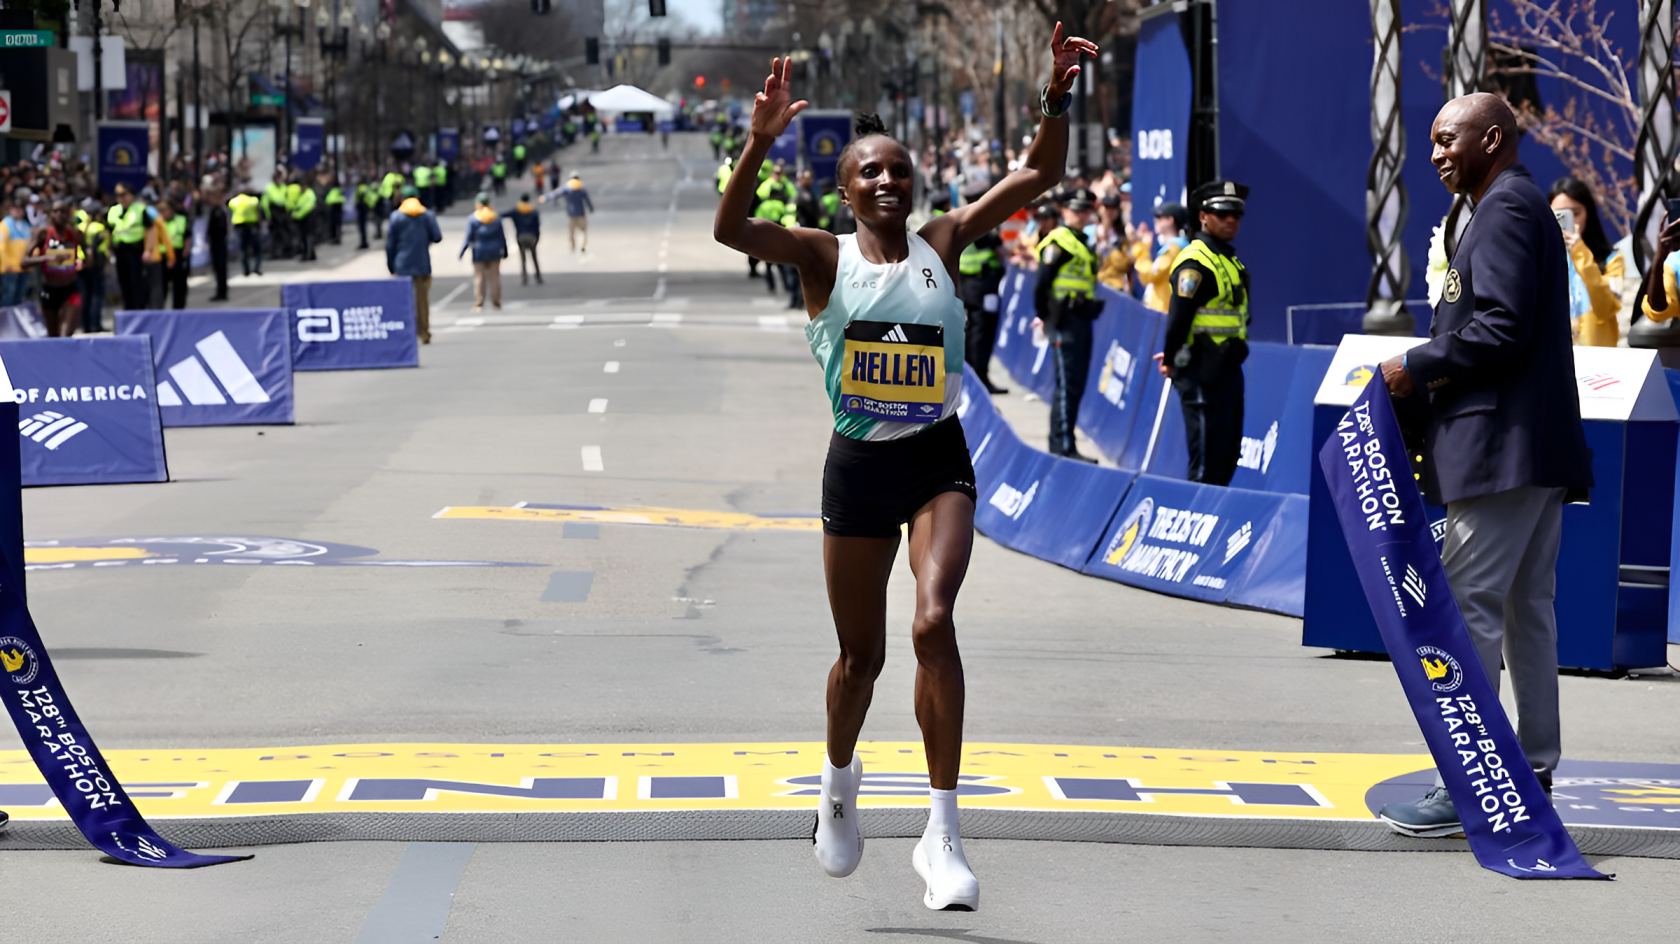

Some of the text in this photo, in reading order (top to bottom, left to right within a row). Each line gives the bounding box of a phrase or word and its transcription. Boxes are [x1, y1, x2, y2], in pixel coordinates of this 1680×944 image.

[13, 384, 147, 404] OF AMERICA
[851, 351, 935, 388] HELLEN
[1364, 438, 1405, 525] BOSTON
[18, 690, 107, 810] MARATHON
[33, 685, 122, 806] 128TH BOSTON
[1436, 697, 1510, 833] MARATHON
[1456, 694, 1488, 736] 128TH
[1477, 739, 1530, 823] BOSTON
